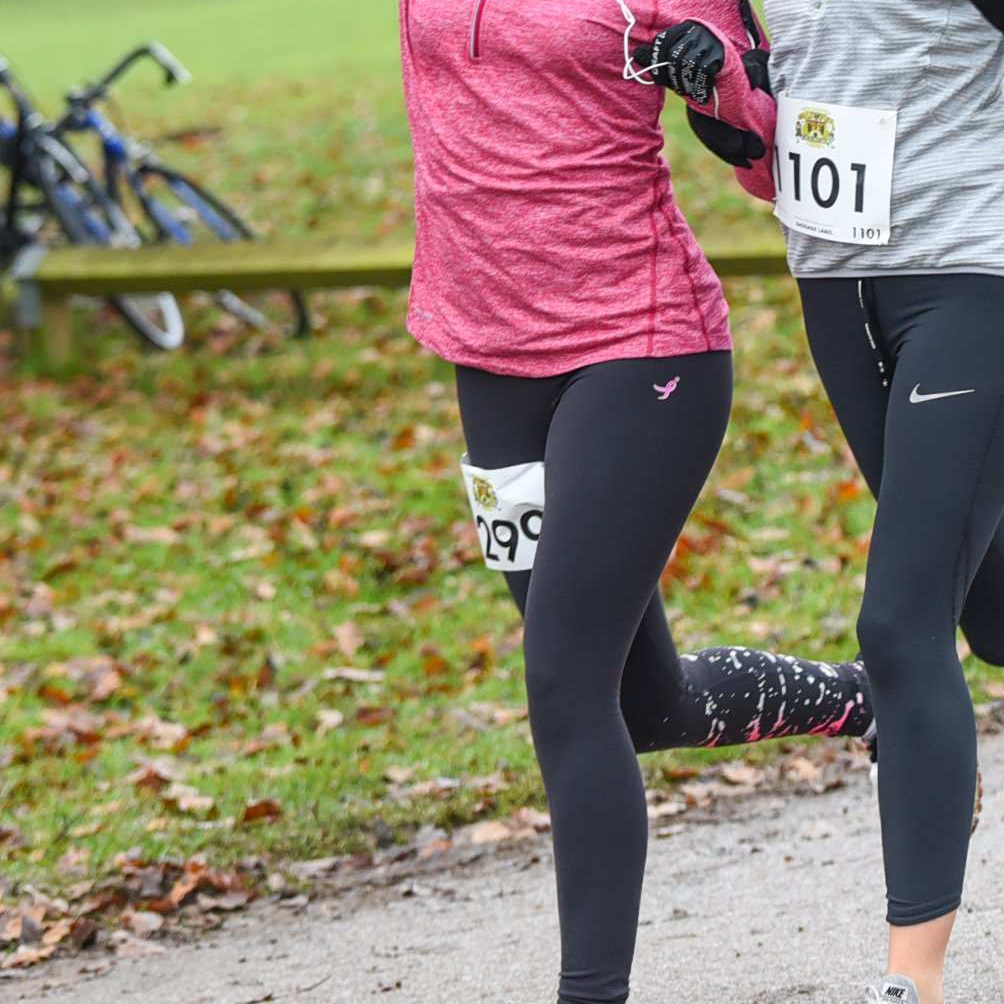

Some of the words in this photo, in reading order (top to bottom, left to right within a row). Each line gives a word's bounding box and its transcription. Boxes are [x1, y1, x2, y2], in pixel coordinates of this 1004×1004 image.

[774, 145, 867, 213] 1101
[853, 226, 881, 240] 1101
[885, 986, 906, 998] NIKE
